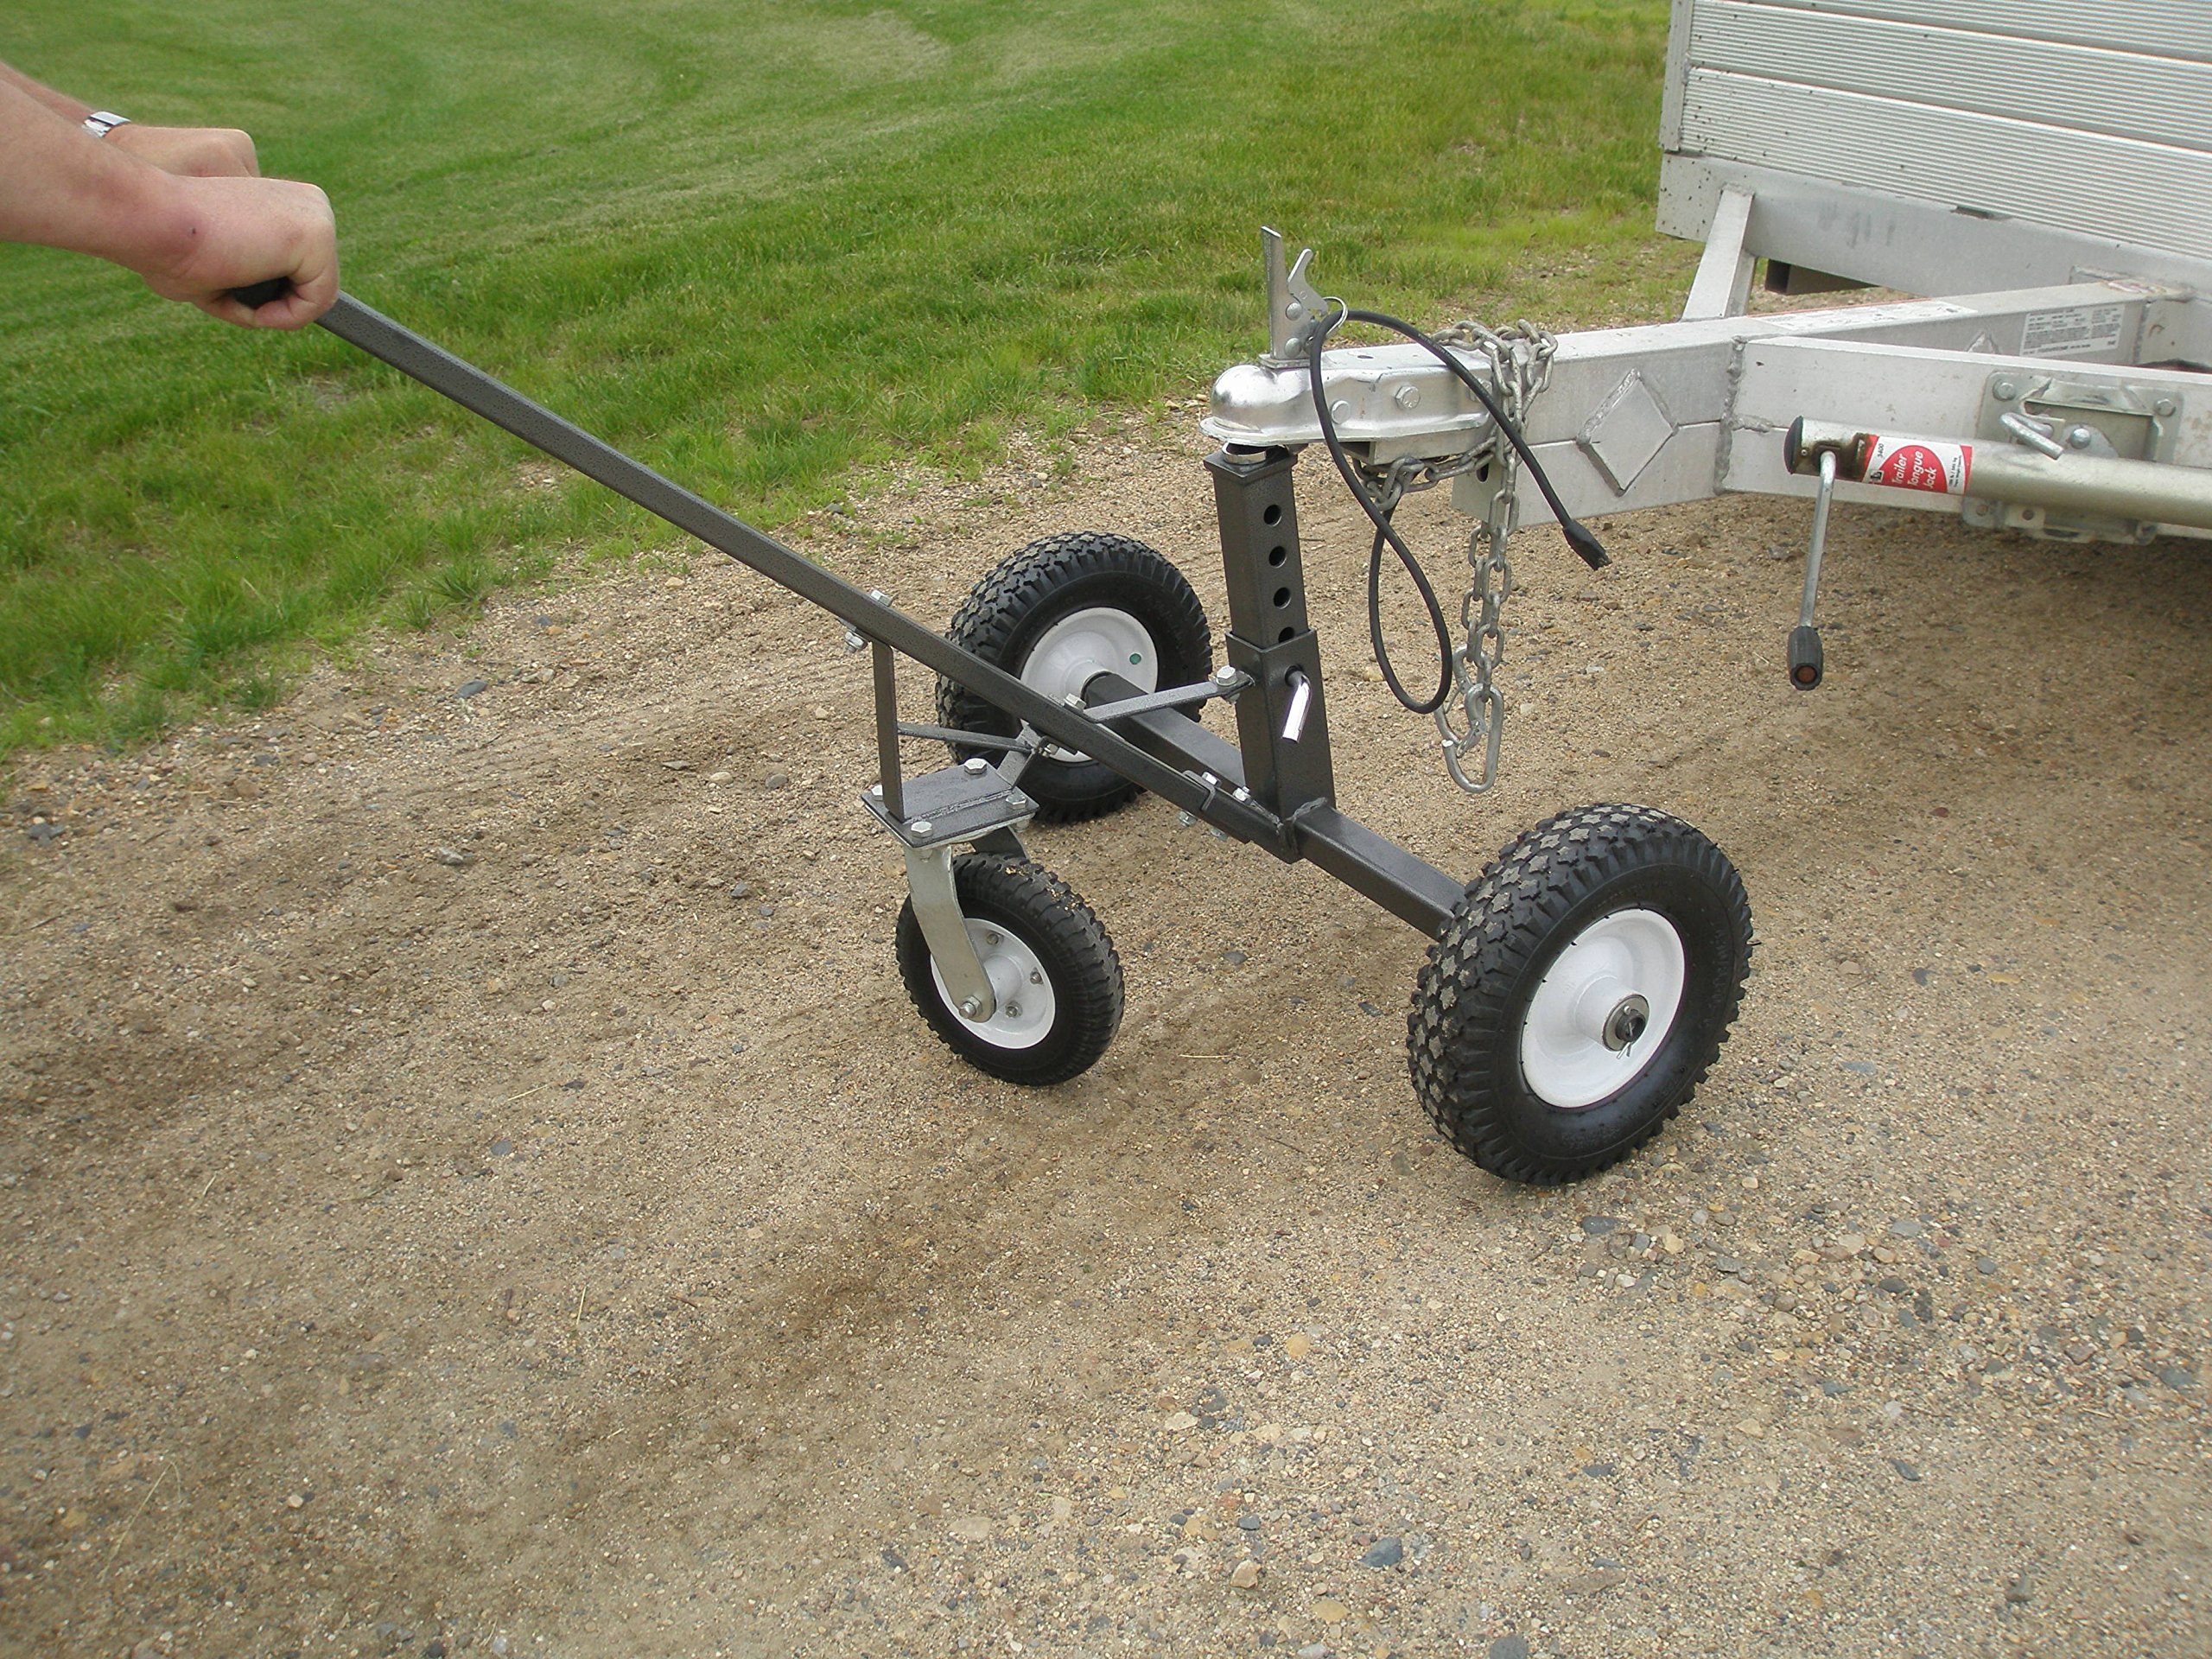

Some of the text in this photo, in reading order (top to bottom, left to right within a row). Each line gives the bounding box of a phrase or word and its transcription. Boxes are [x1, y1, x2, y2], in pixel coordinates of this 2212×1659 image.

[1891, 453, 1908, 484] Trailer
[1907, 450, 1924, 486] Tongue
[1923, 467, 1937, 489] Jack
